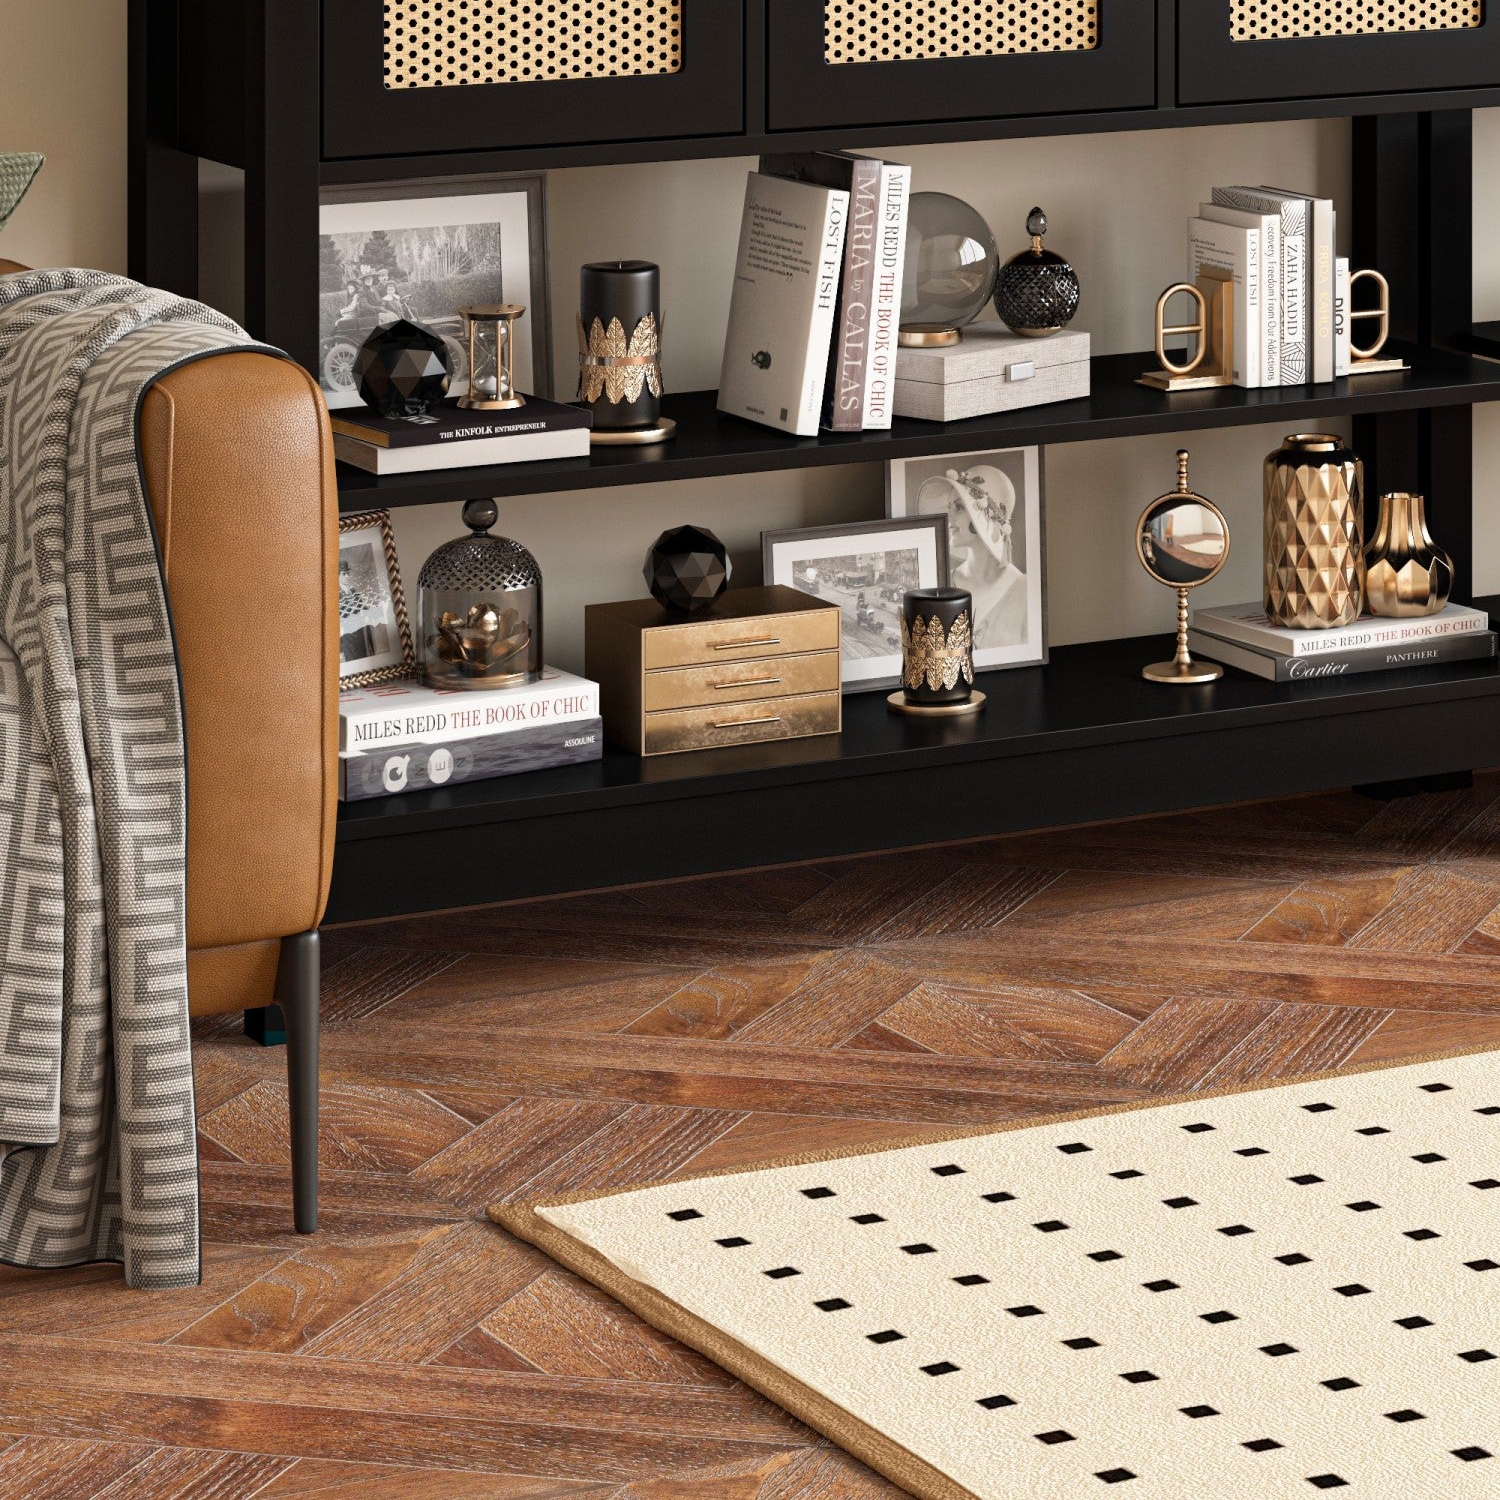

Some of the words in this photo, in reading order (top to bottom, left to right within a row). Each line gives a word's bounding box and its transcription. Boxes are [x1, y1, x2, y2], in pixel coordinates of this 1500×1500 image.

[885, 173, 903, 226] MILES
[826, 196, 844, 254] LOST
[850, 175, 877, 271] MARIA
[881, 225, 900, 269] REDD
[1286, 244, 1298, 285] ZAHA
[1318, 244, 1329, 284] FRIDA
[817, 260, 836, 310] FISH
[850, 279, 865, 293] by
[877, 272, 895, 304] THE
[1267, 261, 1278, 297] Freedom
[1267, 299, 1277, 319] From
[1267, 320, 1277, 337] Our
[1286, 289, 1298, 336] HADID
[1318, 291, 1329, 338] KAHLO
[1335, 297, 1344, 336] DIOR
[874, 308, 892, 355] BOOK
[839, 301, 868, 411] CALLAS
[872, 355, 888, 376] OF
[1267, 338, 1278, 382] Addictions
[869, 380, 887, 419] CHIC
[439, 431, 454, 439] THE
[455, 425, 493, 438] KINFOLK
[494, 421, 547, 434] ENTREPRENEUR
[1300, 638, 1337, 653] MILES
[1339, 633, 1372, 647] REDD
[1373, 630, 1399, 643] THE
[1400, 625, 1433, 640] BOOK
[1435, 622, 1451, 635] OF
[1452, 618, 1482, 632] CHIC
[1285, 657, 1350, 680] Cartier
[1385, 649, 1439, 664] PANTHERE
[353, 716, 402, 742] MILES
[405, 713, 447, 735] REDD
[450, 709, 482, 729] THE
[485, 703, 526, 725] BOOK
[530, 700, 551, 718] OF
[553, 694, 590, 715] CHIC
[563, 734, 596, 748] ASSOULINE
